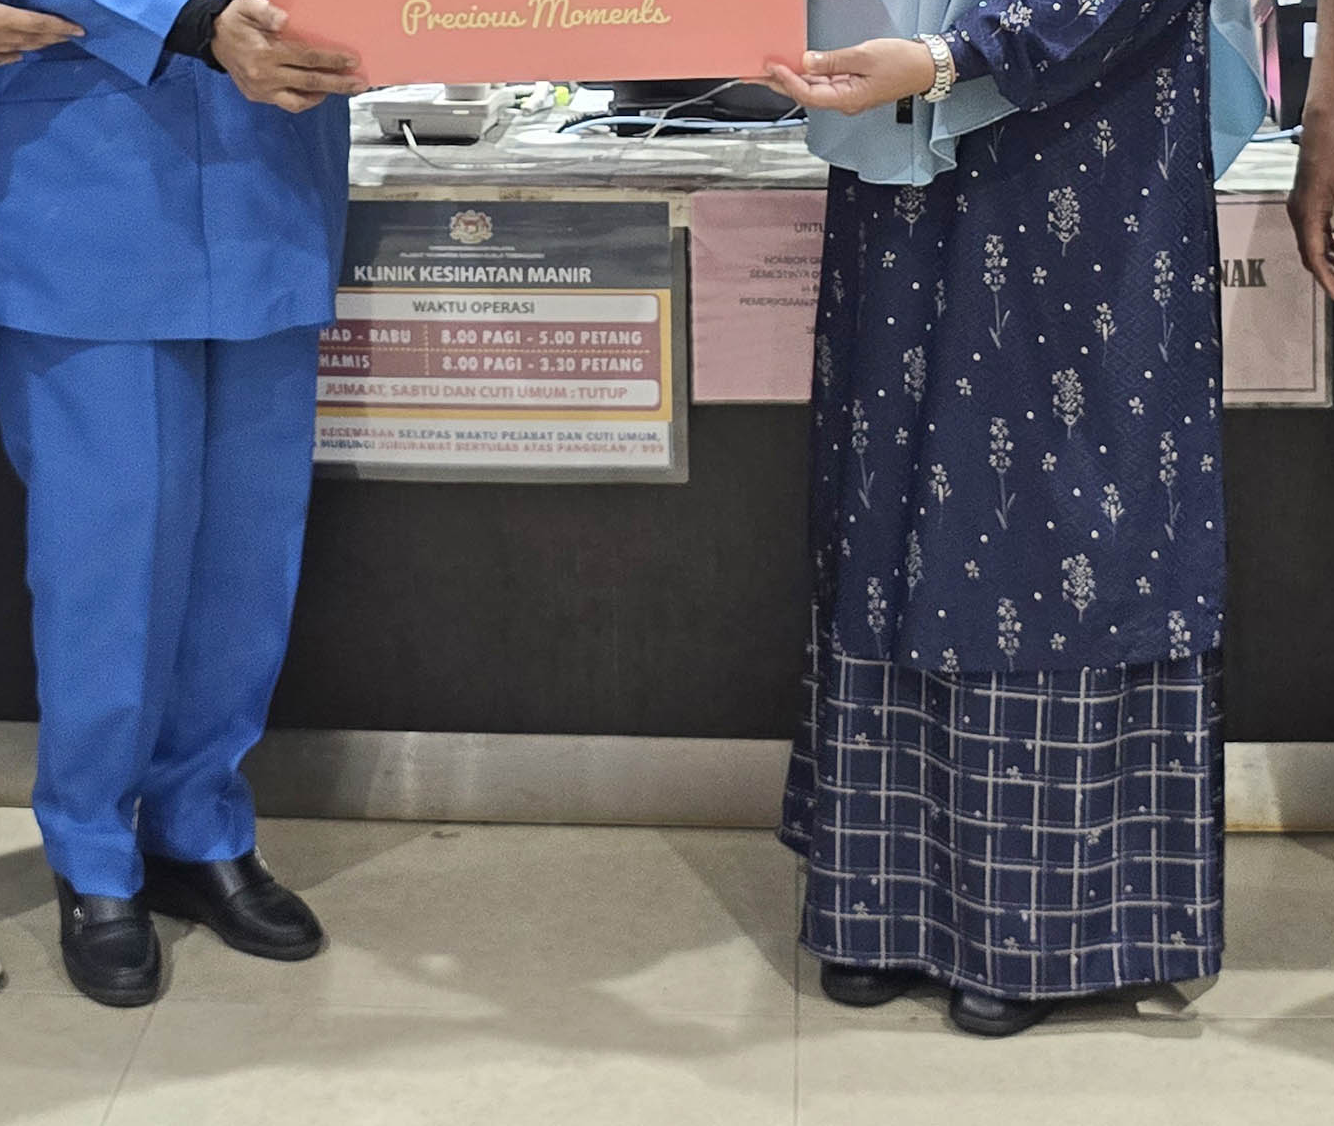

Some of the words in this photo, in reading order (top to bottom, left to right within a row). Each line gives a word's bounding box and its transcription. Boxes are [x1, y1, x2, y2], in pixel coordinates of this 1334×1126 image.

[354, 266, 416, 282] KLINIK
[419, 266, 526, 283] KESIHATAN
[528, 267, 592, 283] MANIR
[413, 300, 468, 314] WAKTU
[471, 301, 535, 314] OPERASI
[319, 329, 351, 343] HAD
[369, 330, 411, 344] RABU
[441, 330, 477, 344] 8.00
[482, 331, 521, 344] PAGI
[538, 331, 575, 344] 5.00
[580, 331, 643, 345] PETANG
[319, 354, 371, 369] HAMIS
[442, 357, 478, 371] 8.00
[483, 357, 522, 371] PAGI
[539, 357, 575, 371] 3.30
[581, 357, 643, 372] PETANG
[391, 385, 439, 398] SABTU
[443, 386, 476, 398] DAN
[480, 387, 513, 399] CUTI
[518, 387, 566, 399] UMUM
[578, 387, 628, 399] TUTUP
[397, 429, 452, 440] SELEPAS
[558, 431, 583, 442] DAN
[586, 432, 614, 442] CUTI
